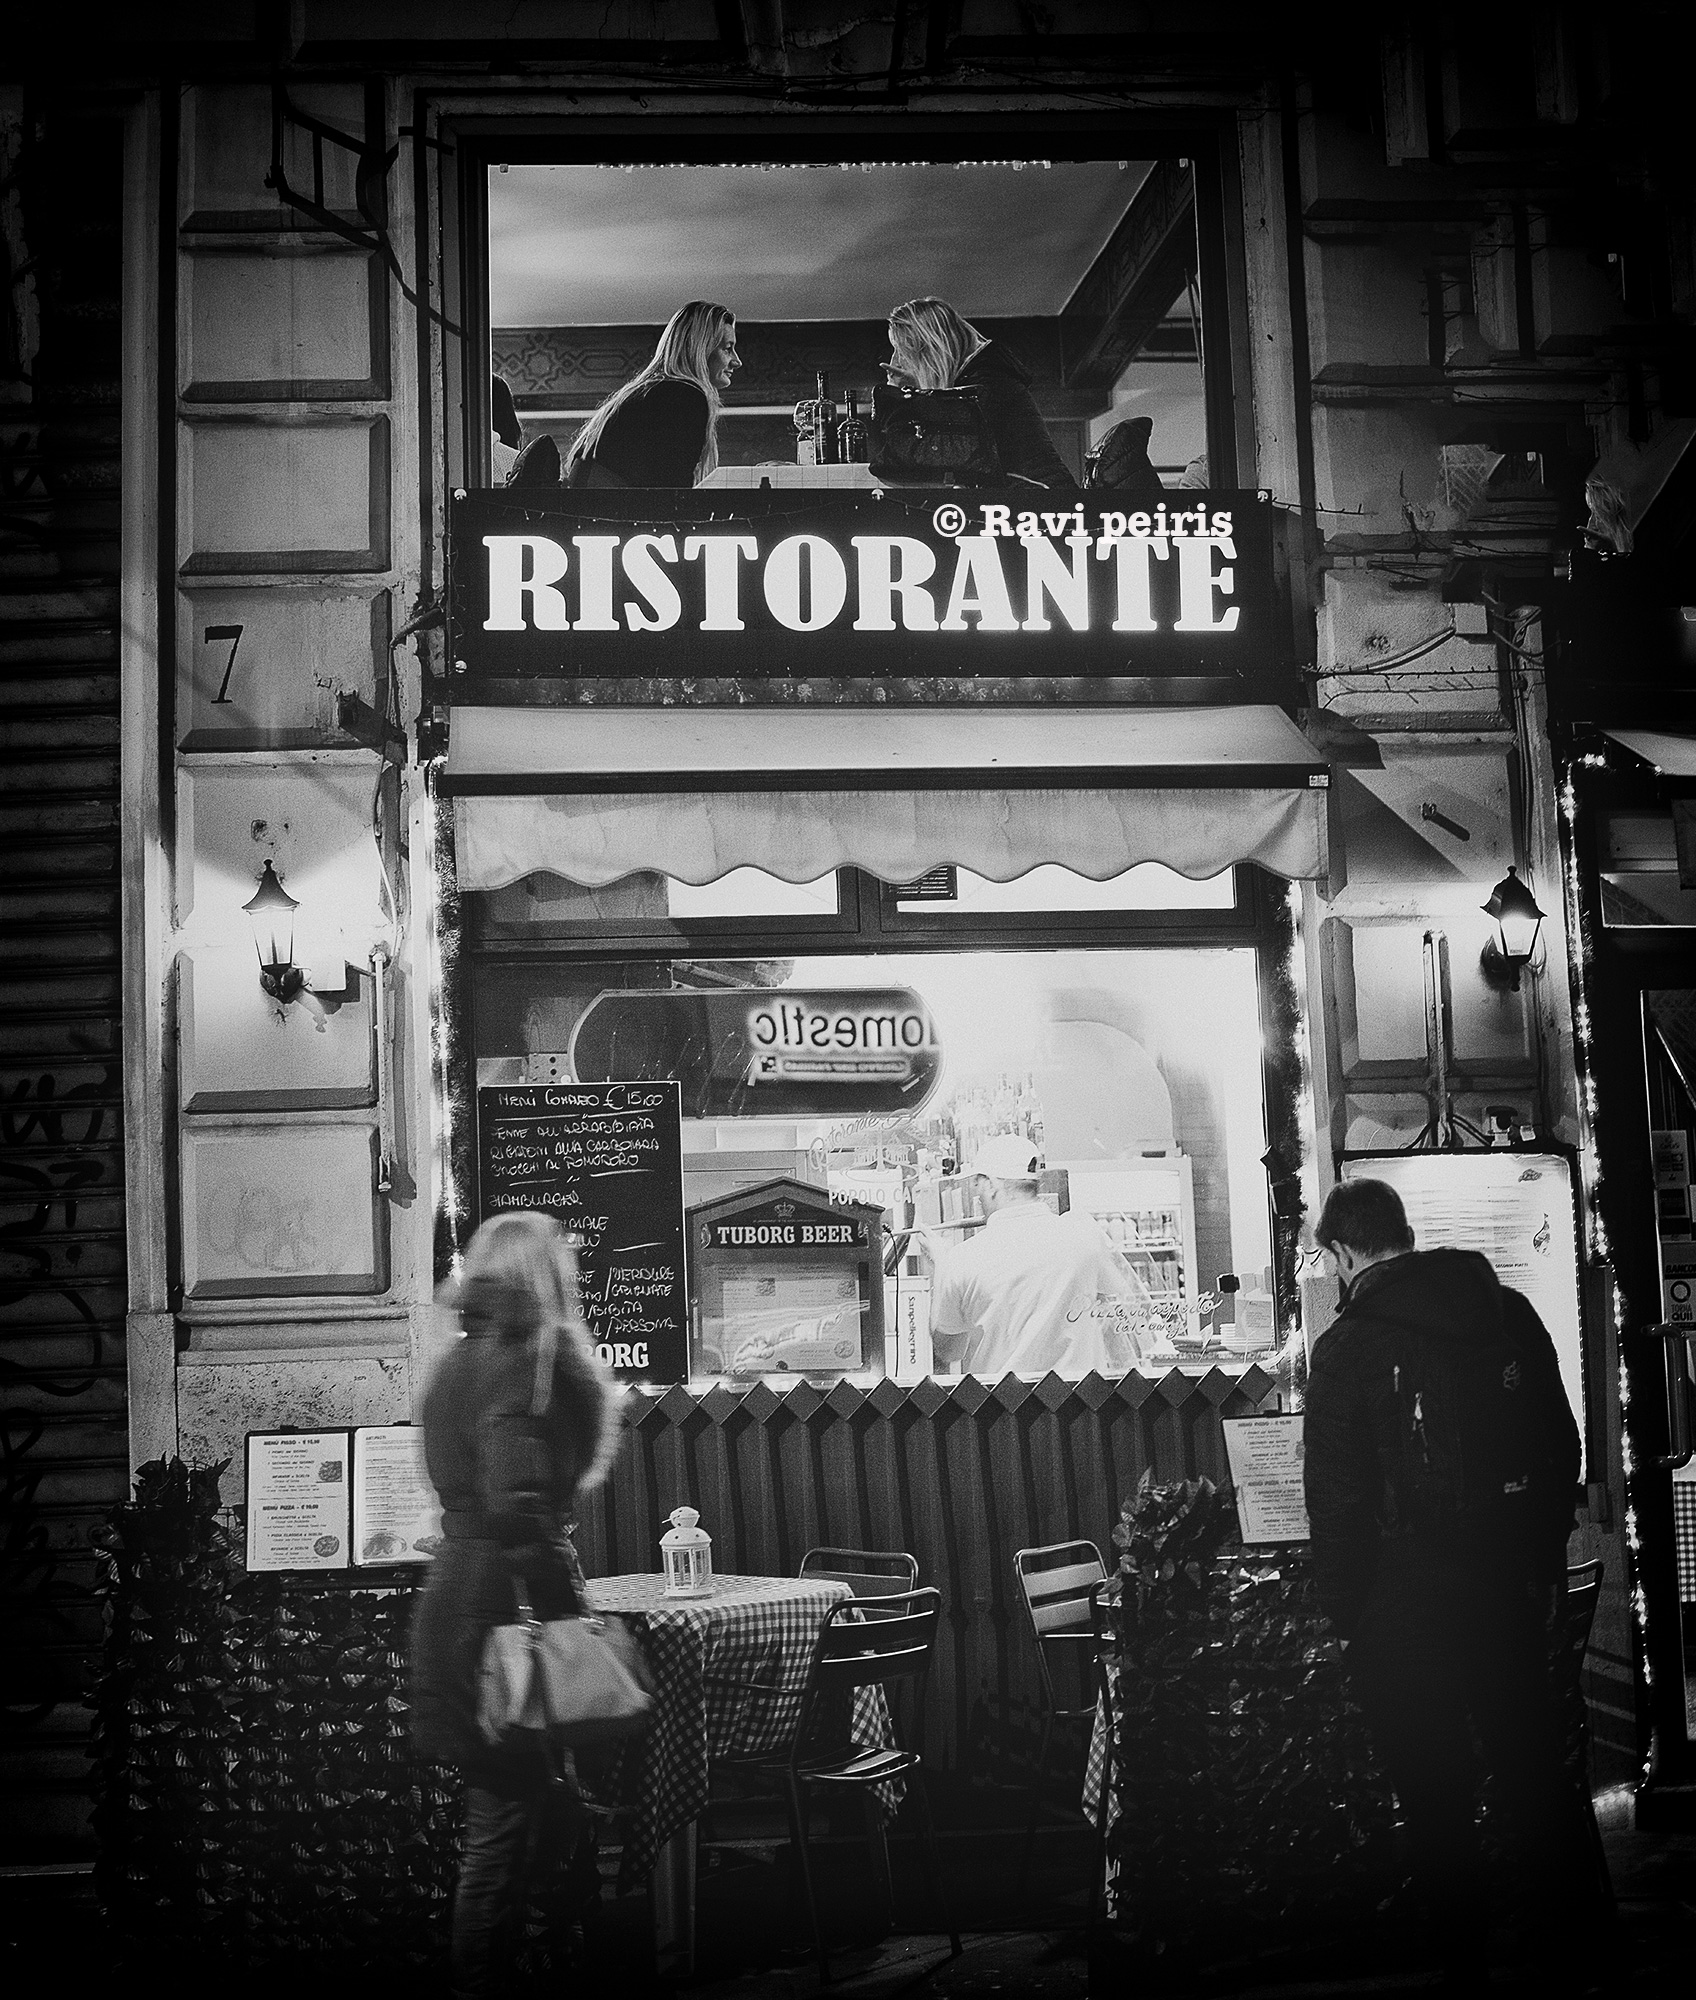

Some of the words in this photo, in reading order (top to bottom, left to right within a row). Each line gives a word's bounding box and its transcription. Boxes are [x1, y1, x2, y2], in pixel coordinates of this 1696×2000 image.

[483, 535, 1239, 632] RISTORANTE
[204, 624, 243, 704] 7
[717, 1225, 796, 1245] TUBORG
[802, 1225, 854, 1244] BEER
